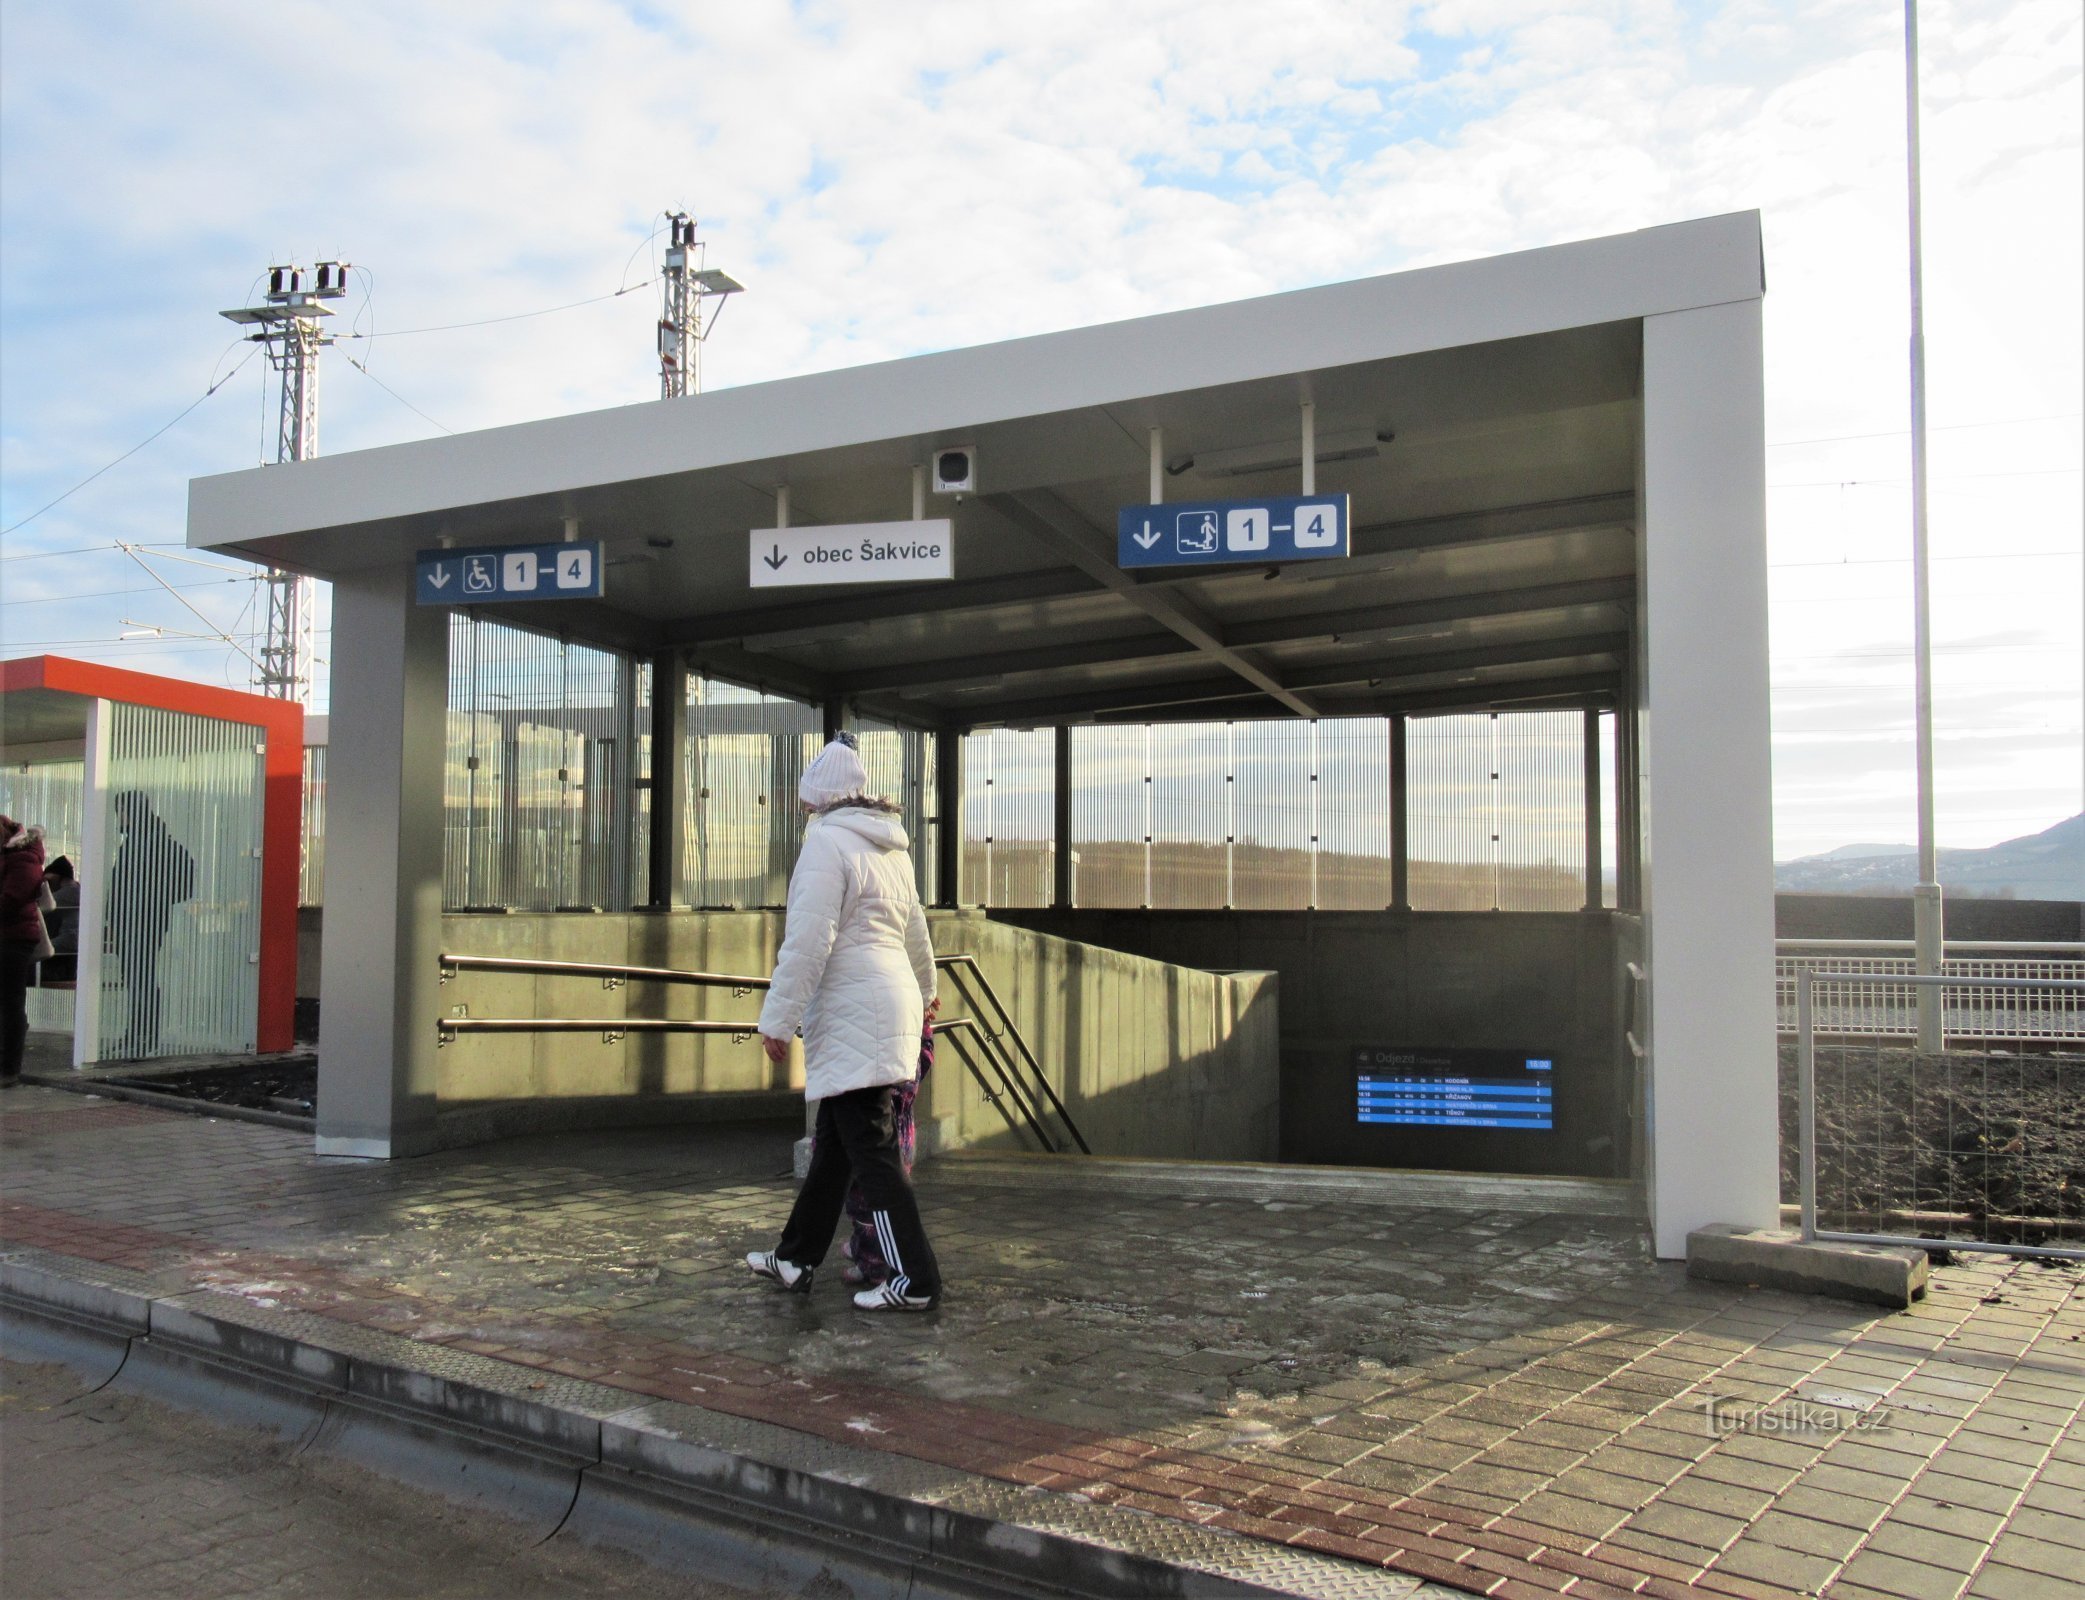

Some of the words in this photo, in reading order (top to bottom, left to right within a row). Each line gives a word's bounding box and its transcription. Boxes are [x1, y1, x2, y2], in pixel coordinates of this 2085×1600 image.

[803, 545, 853, 564] obec
[860, 538, 941, 561] Šakvice
[1375, 1052, 1415, 1066] Odjezd
